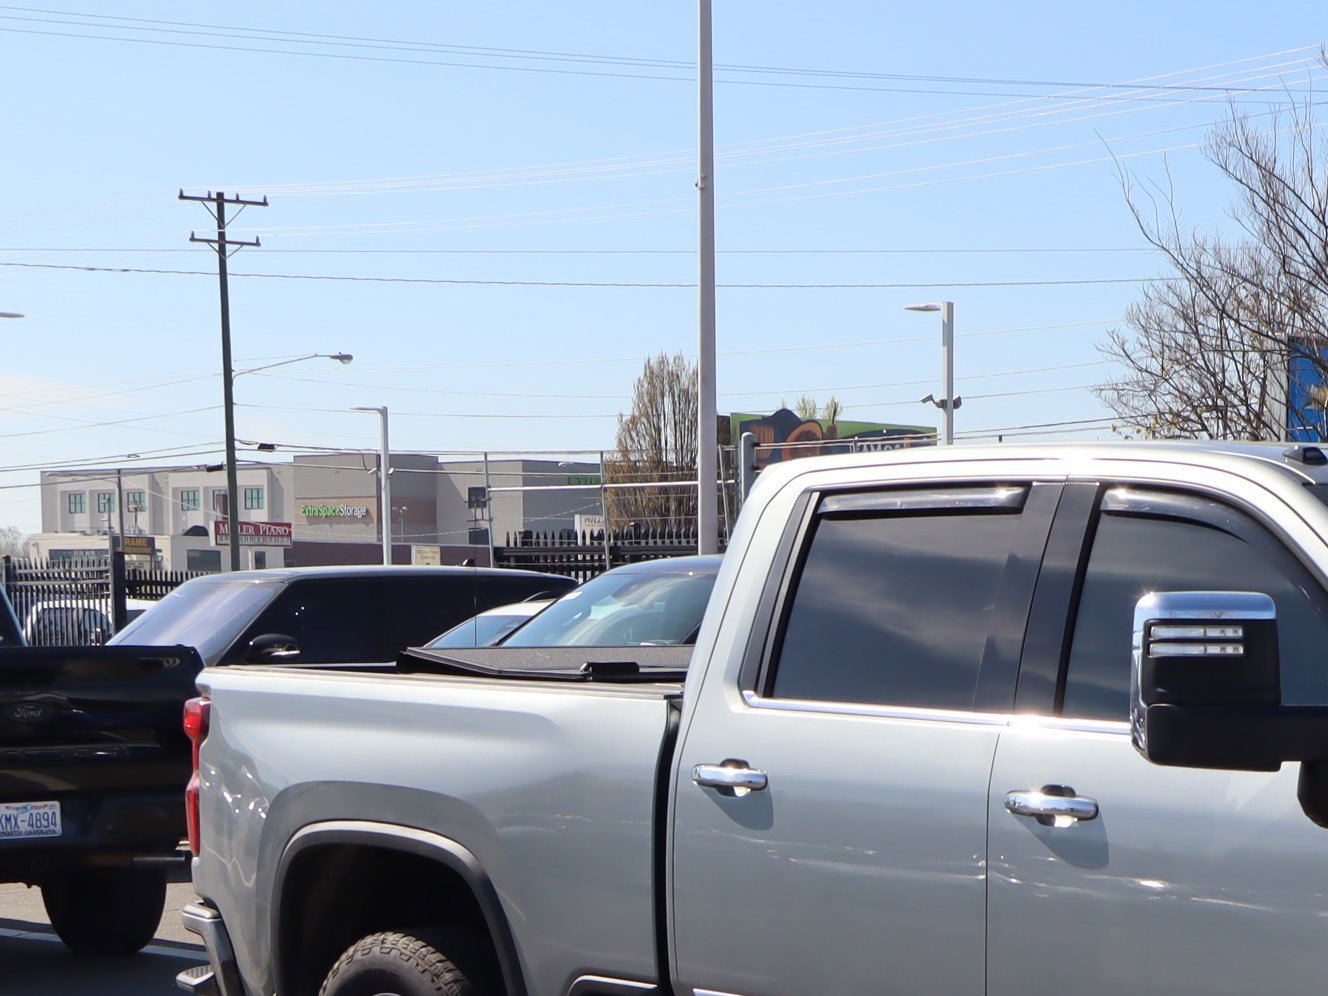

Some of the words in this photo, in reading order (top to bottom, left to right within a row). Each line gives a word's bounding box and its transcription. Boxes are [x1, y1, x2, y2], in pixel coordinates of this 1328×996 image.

[219, 523, 255, 535] MLER
[259, 524, 289, 536] PIANO
[14, 705, 42, 719] Ford
